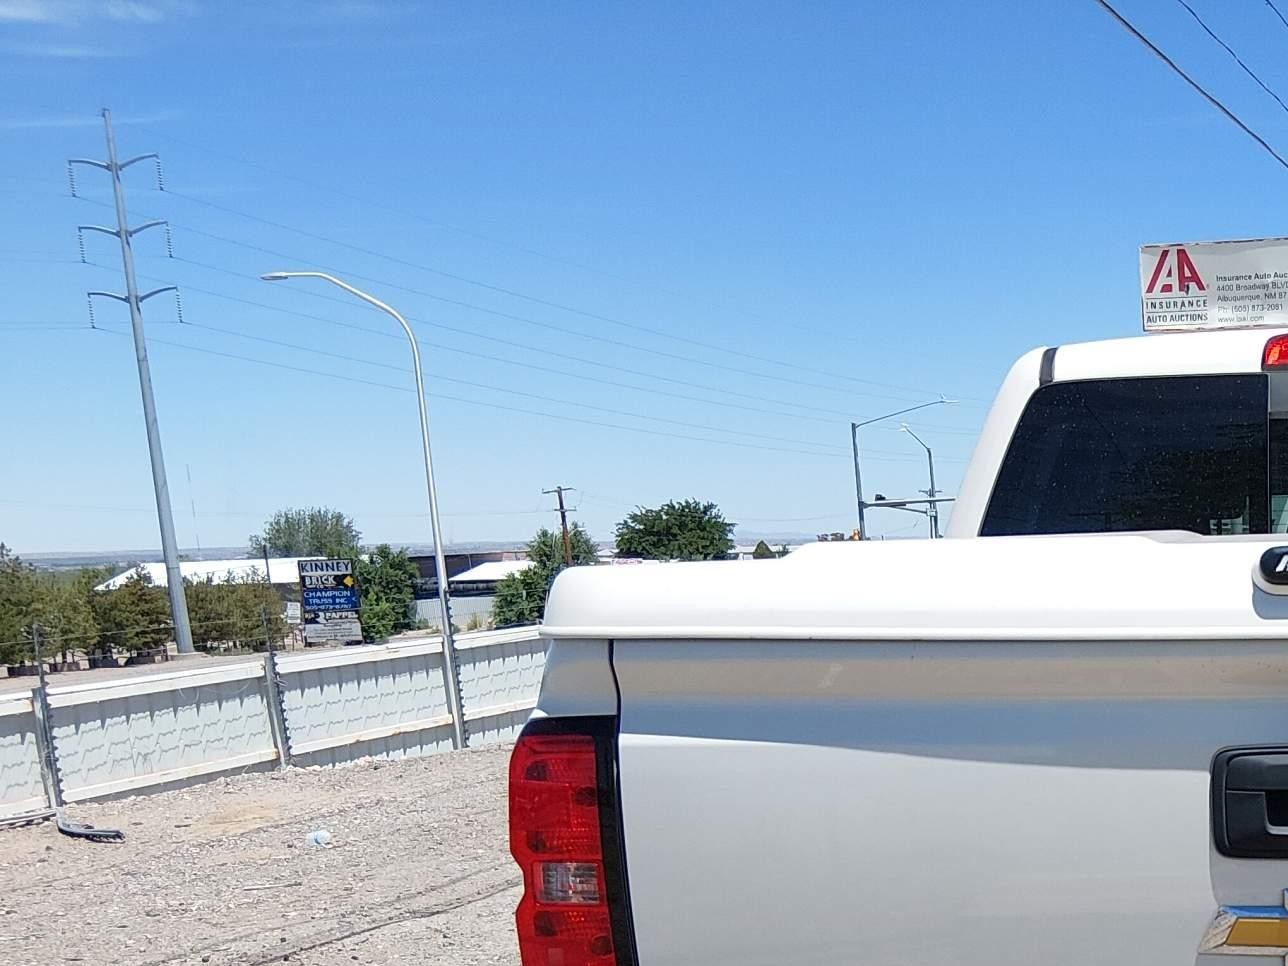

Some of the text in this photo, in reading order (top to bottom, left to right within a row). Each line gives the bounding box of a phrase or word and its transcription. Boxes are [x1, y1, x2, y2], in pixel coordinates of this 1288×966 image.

[1216, 273, 1253, 282] Insurance
[1254, 272, 1272, 281] Auto
[1216, 284, 1234, 292] 4400
[1235, 282, 1270, 291] Broadway
[1264, 292, 1277, 300] NM
[1145, 299, 1208, 310] INSURANCE
[1231, 304, 1250, 314] (505)
[1146, 312, 1208, 324] AUTO AUCTIONS
[301, 561, 350, 573] KINNEY
[305, 575, 337, 585] BRICK
